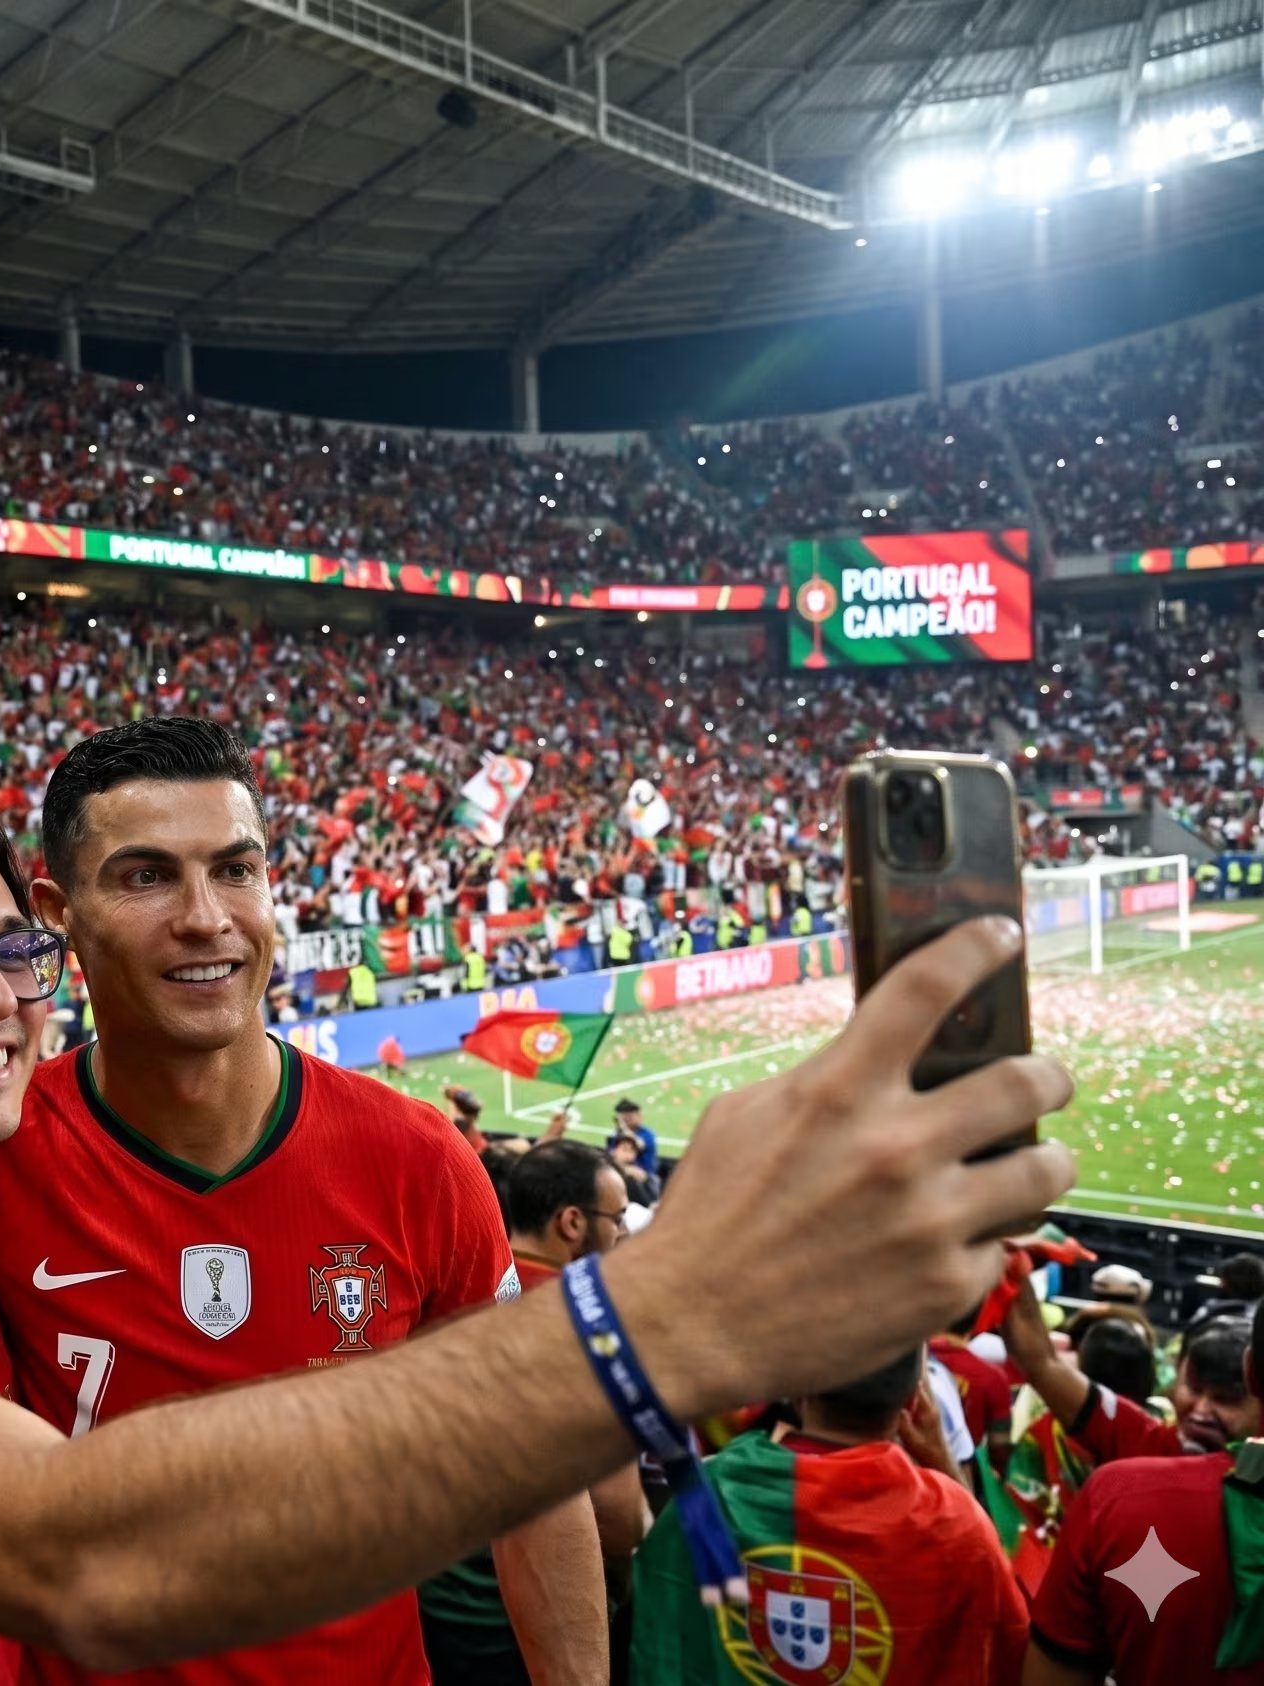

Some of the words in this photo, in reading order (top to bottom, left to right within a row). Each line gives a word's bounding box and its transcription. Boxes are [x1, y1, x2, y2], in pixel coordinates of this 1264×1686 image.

[110, 535, 218, 569] PORTUGAL
[842, 562, 998, 602] PORTUGAL
[843, 596, 997, 639] CAMPEÃO!
[57, 1332, 116, 1440] 7
